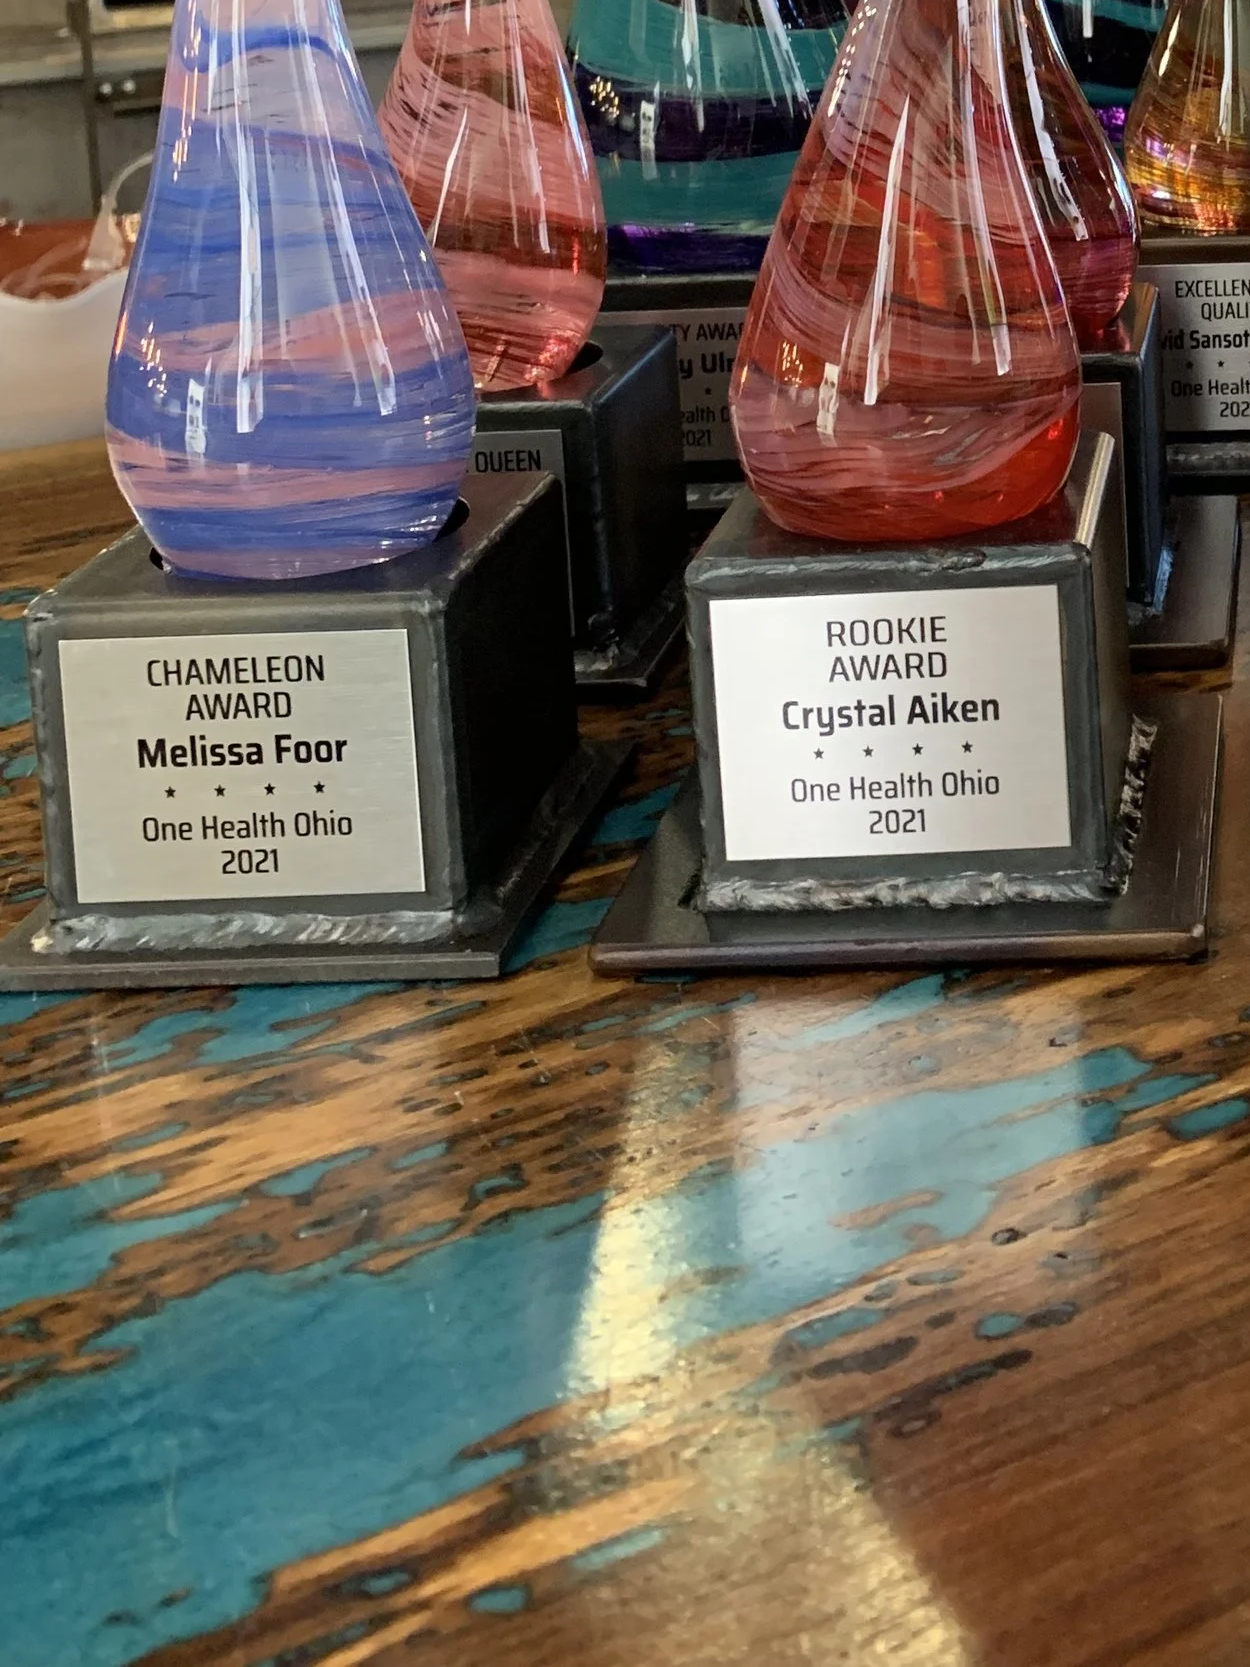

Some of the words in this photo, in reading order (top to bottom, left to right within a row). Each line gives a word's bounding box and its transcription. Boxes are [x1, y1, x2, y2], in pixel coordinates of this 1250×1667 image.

[1161, 330, 1185, 351] vid
[1171, 380, 1203, 397] One
[685, 429, 711, 447] 021
[475, 450, 542, 473] QUEEN
[826, 616, 948, 647] ROOKIE
[147, 654, 325, 687] CHAMELEON
[829, 651, 948, 683] AWARD
[185, 691, 292, 721] AWARD
[782, 694, 896, 737] Crystal
[907, 691, 1000, 726] Aiken
[137, 734, 264, 769] Melissa
[274, 733, 348, 765] Foor
[791, 778, 841, 803] One
[849, 772, 933, 800] Health
[942, 769, 1000, 797] Ohio
[142, 817, 193, 842] One
[201, 811, 286, 840] Health
[294, 809, 352, 837] Ohio
[869, 809, 926, 835] 2021
[221, 848, 279, 875] 2021
